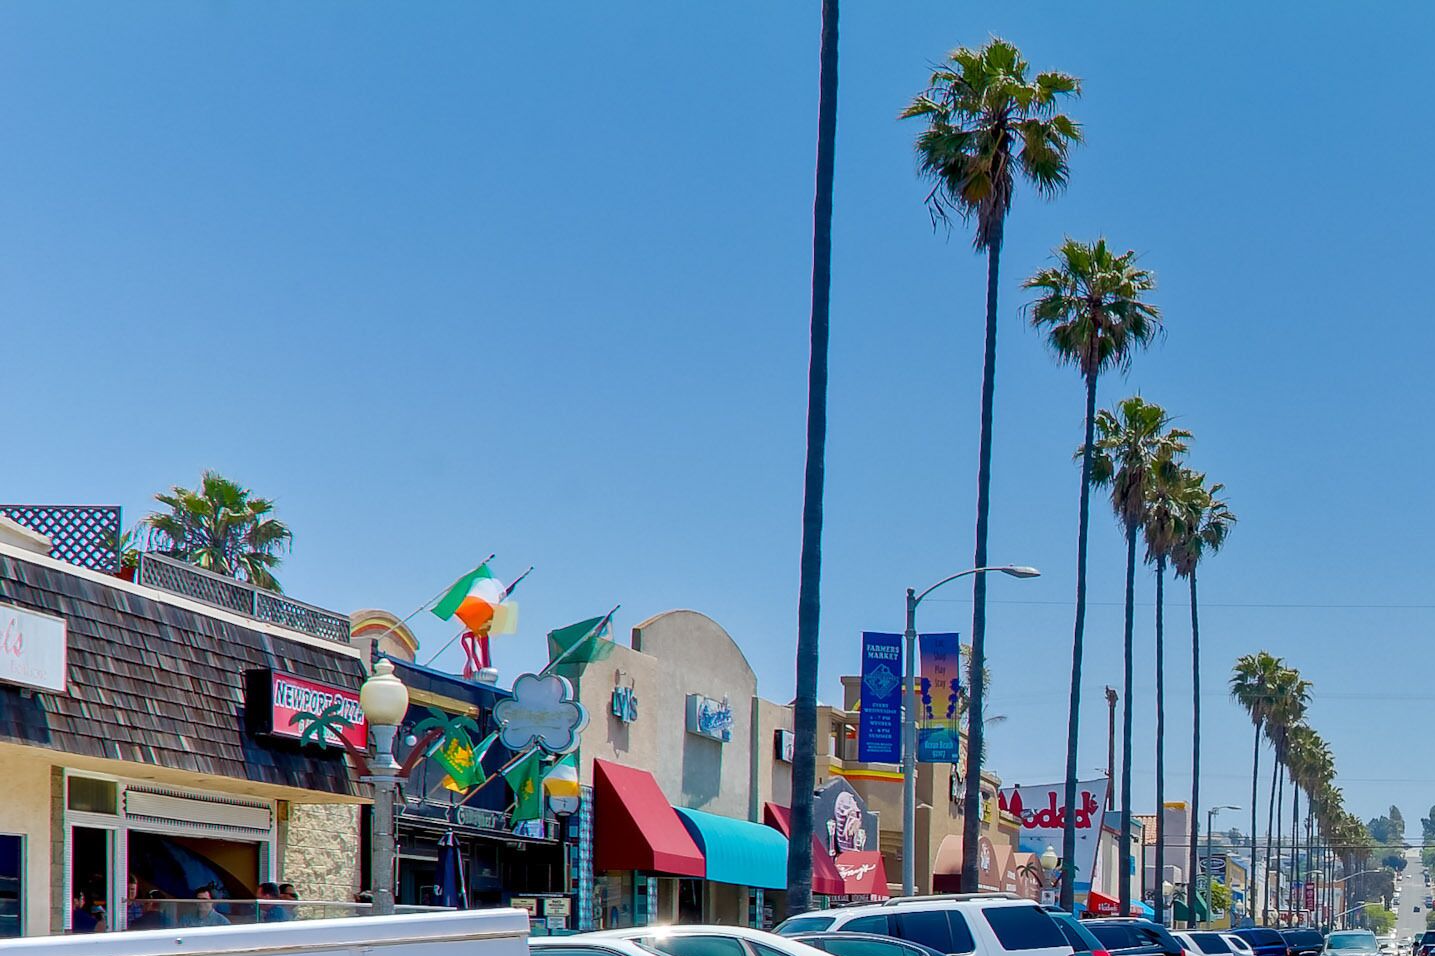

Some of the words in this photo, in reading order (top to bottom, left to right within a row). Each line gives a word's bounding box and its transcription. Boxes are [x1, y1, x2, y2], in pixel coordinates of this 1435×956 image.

[866, 644, 900, 653] FARMERS
[867, 651, 899, 661] MARKET
[934, 665, 946, 676] Play
[275, 680, 333, 716] NEWPORT
